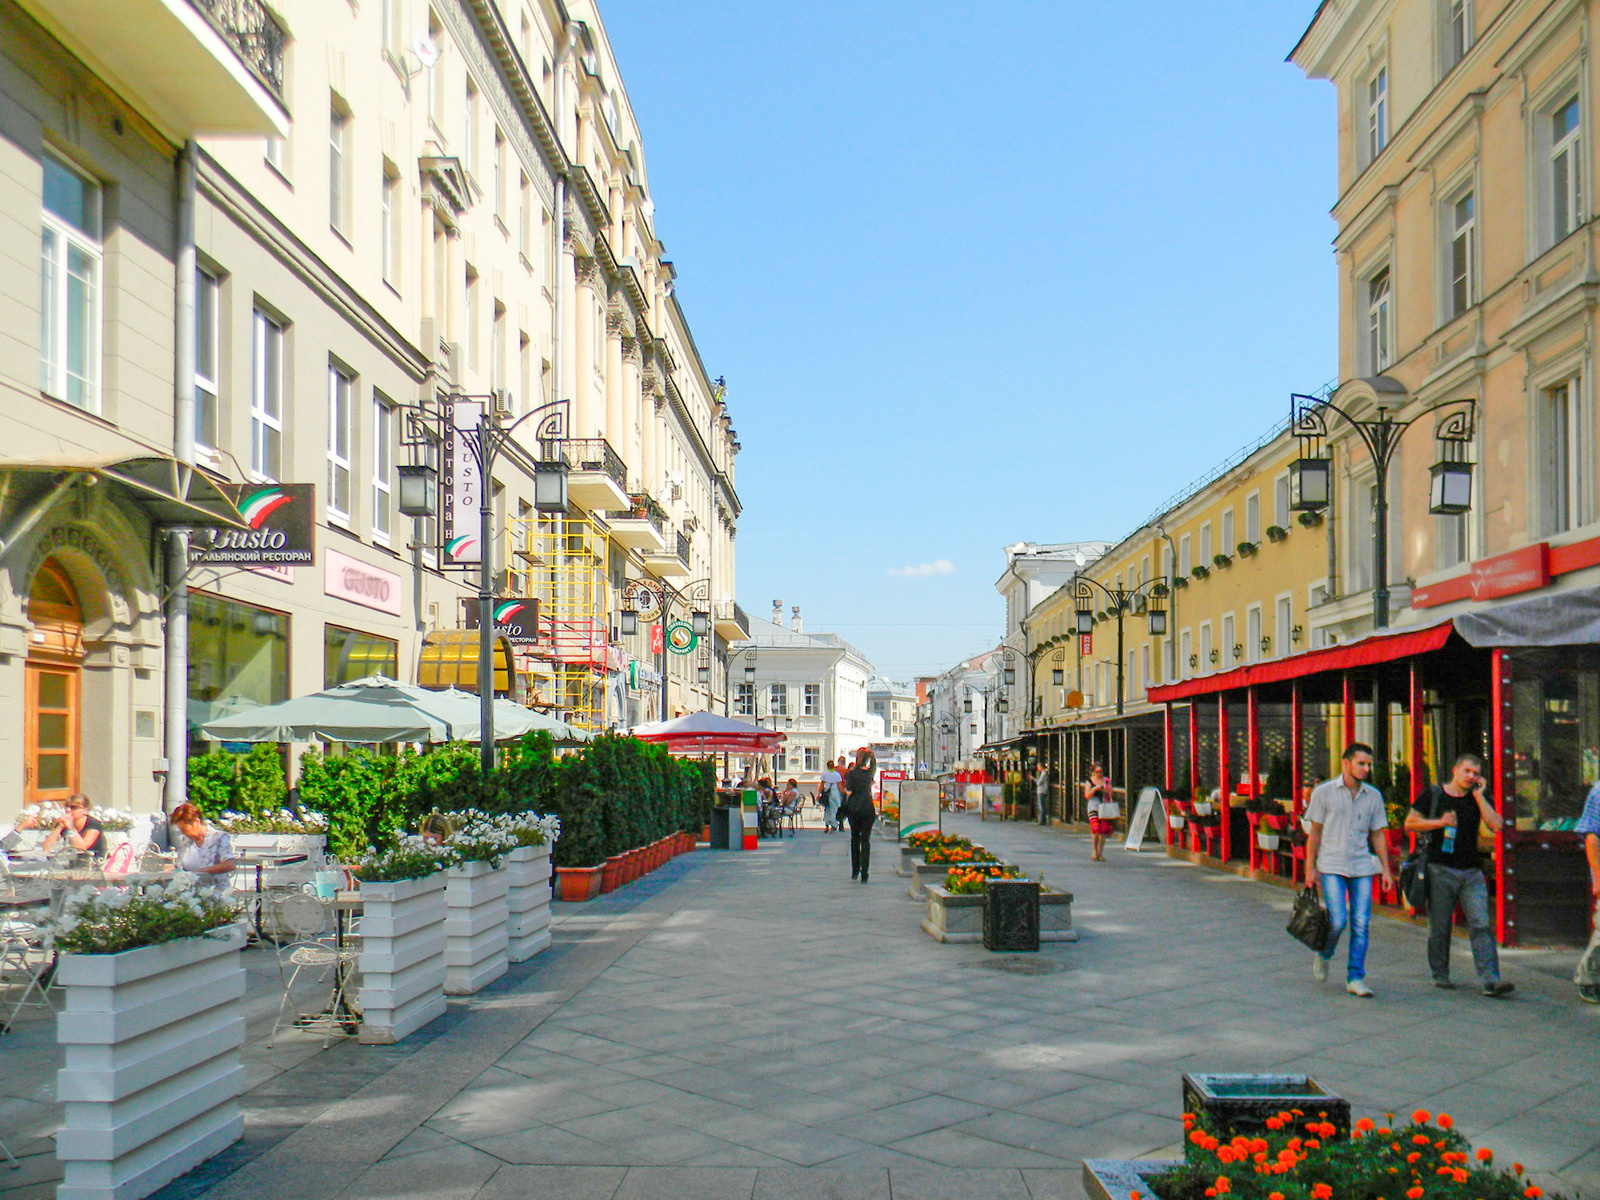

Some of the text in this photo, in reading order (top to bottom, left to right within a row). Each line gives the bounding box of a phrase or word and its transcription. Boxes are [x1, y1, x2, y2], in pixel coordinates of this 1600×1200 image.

[445, 405, 453, 539] ресторан
[462, 438, 473, 506] GUSTO
[263, 552, 311, 561] РЕСТОРАН
